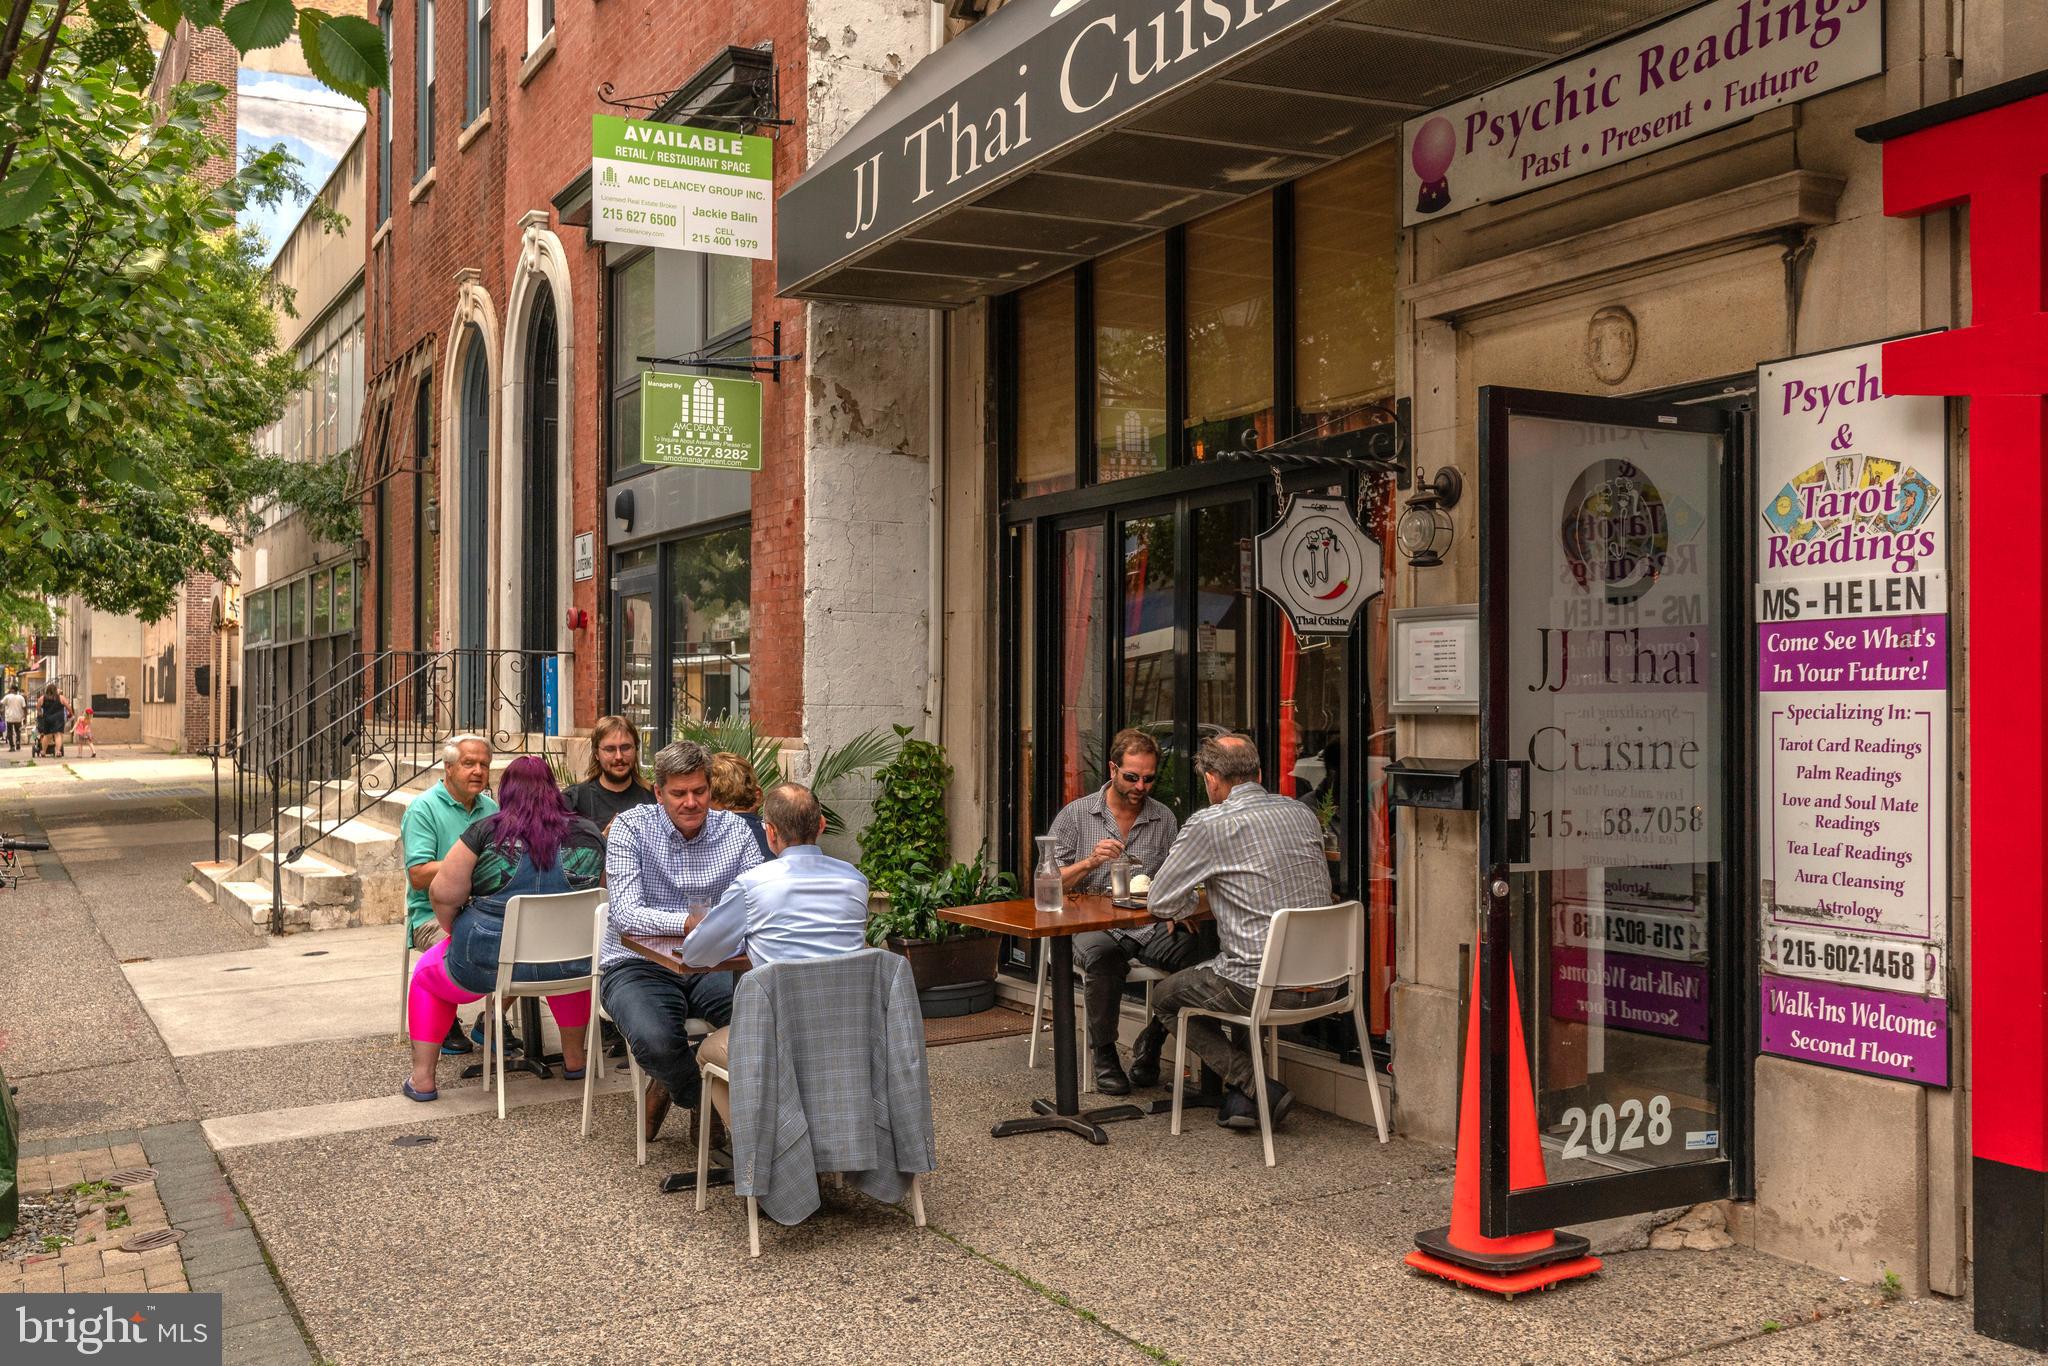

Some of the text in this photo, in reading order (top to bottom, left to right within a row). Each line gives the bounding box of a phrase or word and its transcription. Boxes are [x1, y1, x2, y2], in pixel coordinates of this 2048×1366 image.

[845, 0, 1291, 240] JJ Thai Cuis
[1465, 67, 1621, 158] Psychic
[1520, 60, 1819, 181] Past Present Future
[624, 125, 743, 156] AVAILABLE
[615, 145, 648, 161] RETAIL
[657, 152, 718, 169] RESTAURANT
[721, 160, 751, 174] SPACE
[627, 175, 766, 201] AMC DELANCEY GROUP INC.
[627, 197, 640, 205] Real
[641, 199, 659, 207] Estate
[659, 201, 677, 209] Broker
[692, 206, 758, 224] Jackie Balin
[602, 207, 677, 227] 215 627 6500
[614, 226, 665, 238] amcdelancey.com
[692, 233, 758, 249] 215 400 1979
[715, 227, 735, 236] CELL
[647, 380, 674, 389] Managed
[1782, 363, 1897, 424] Psych
[673, 422, 733, 434] AMC DELANCEY
[1830, 423, 1853, 450] &
[656, 443, 749, 460] 215.627.8282
[661, 436, 679, 445] Inquire
[680, 437, 695, 445] About
[696, 438, 722, 448] Availability
[663, 455, 742, 467] amcdmanagement.com
[1800, 478, 1898, 520] Tarot
[581, 542, 587, 555] NO
[1768, 524, 1935, 575] Readings
[1296, 615, 1350, 626] Thai Cuisine
[1767, 626, 1936, 652] Come See What's
[1528, 627, 1572, 692] JJ
[1604, 627, 1700, 685] Thai
[1773, 660, 1929, 683] In Your Future!
[1787, 703, 1911, 727] Specializing In:
[1779, 737, 1922, 760] Tarot Card Readings
[1796, 764, 1902, 789] Palm Readings
[1782, 793, 1919, 813] Love and Soul Mate
[1815, 814, 1880, 837] Readings
[1787, 840, 1913, 869] Tea Leaf Readings
[1794, 868, 1906, 898] Aura Cleansing
[1816, 899, 1883, 924] Astrology
[1783, 938, 1915, 980] 215-602-1458
[1770, 988, 1937, 1039] Walk-Ins Welcome
[1790, 1029, 1913, 1068] Second Floor
[1561, 1095, 1673, 1160] 2028
